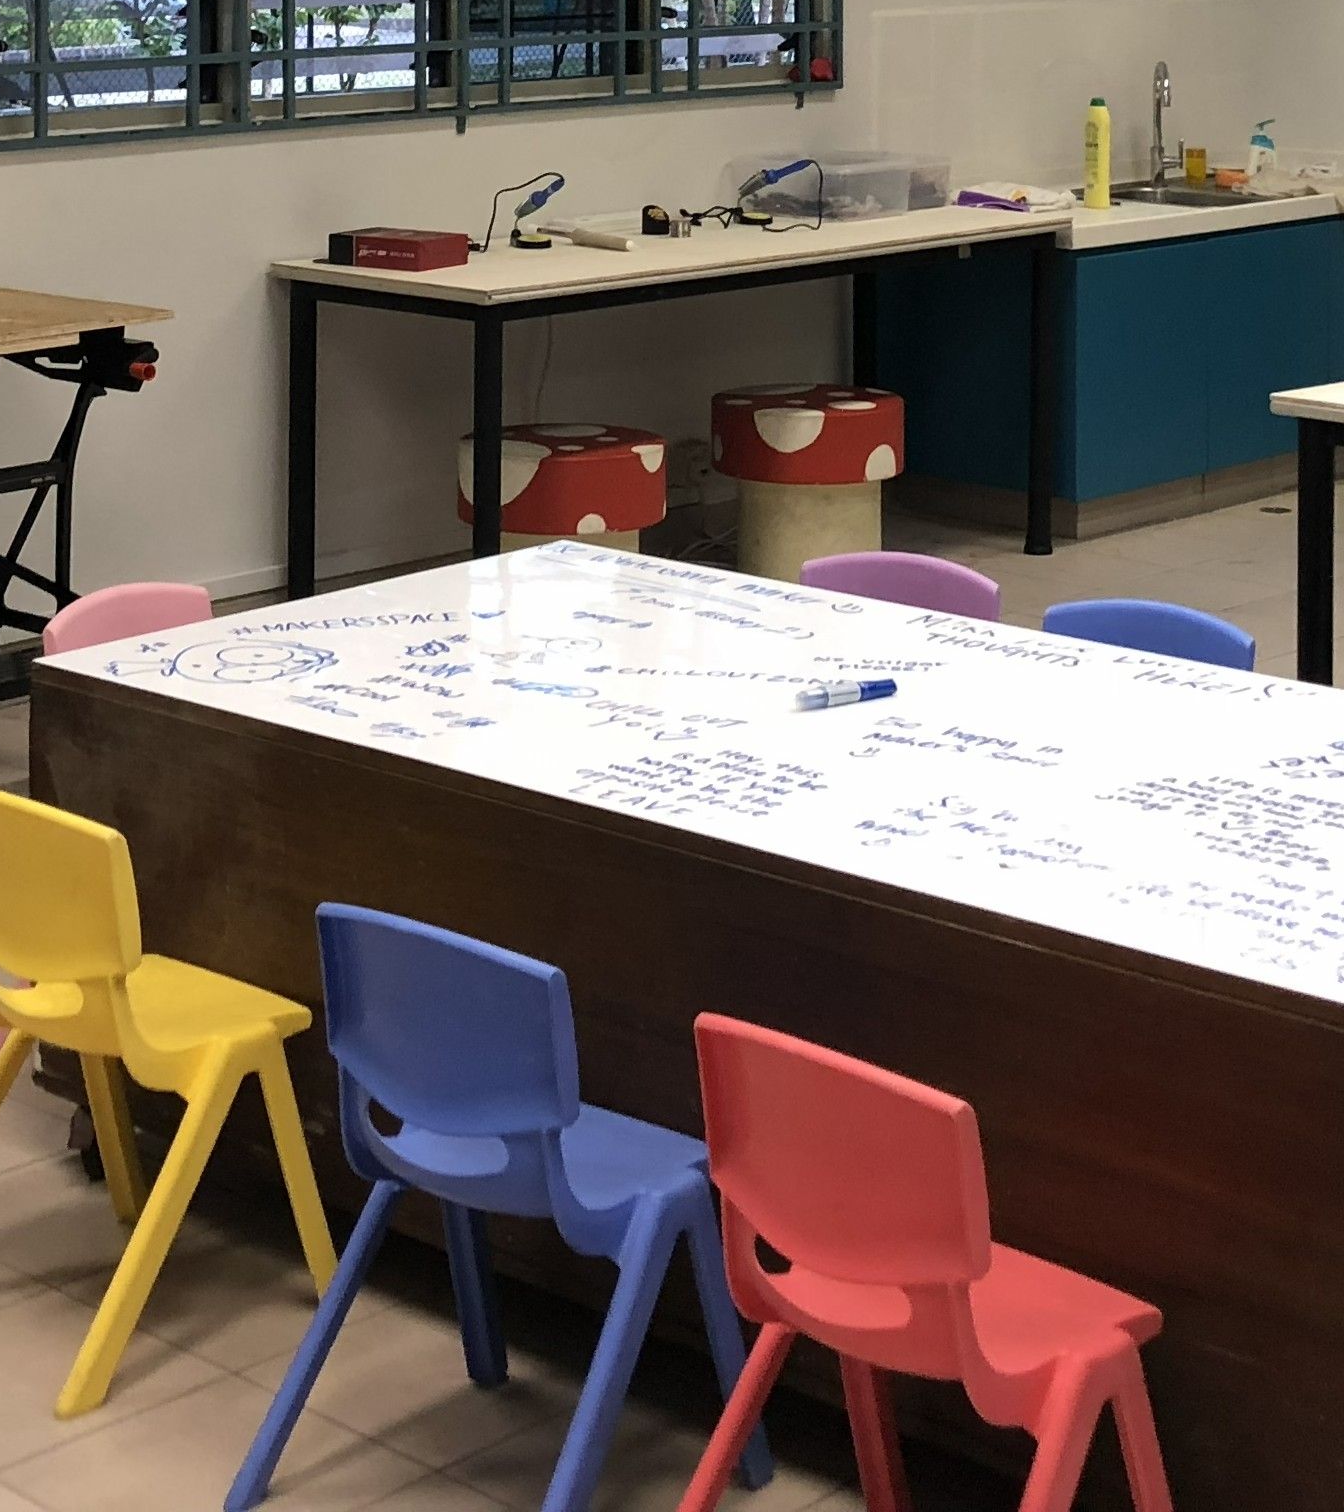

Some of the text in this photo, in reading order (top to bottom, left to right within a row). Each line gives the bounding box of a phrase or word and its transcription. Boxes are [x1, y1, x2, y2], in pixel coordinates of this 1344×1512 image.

[230, 610, 460, 637] #MAKERSSPACE
[940, 725, 1019, 750] happy
[1035, 744, 1064, 755] in
[775, 762, 824, 779] this
